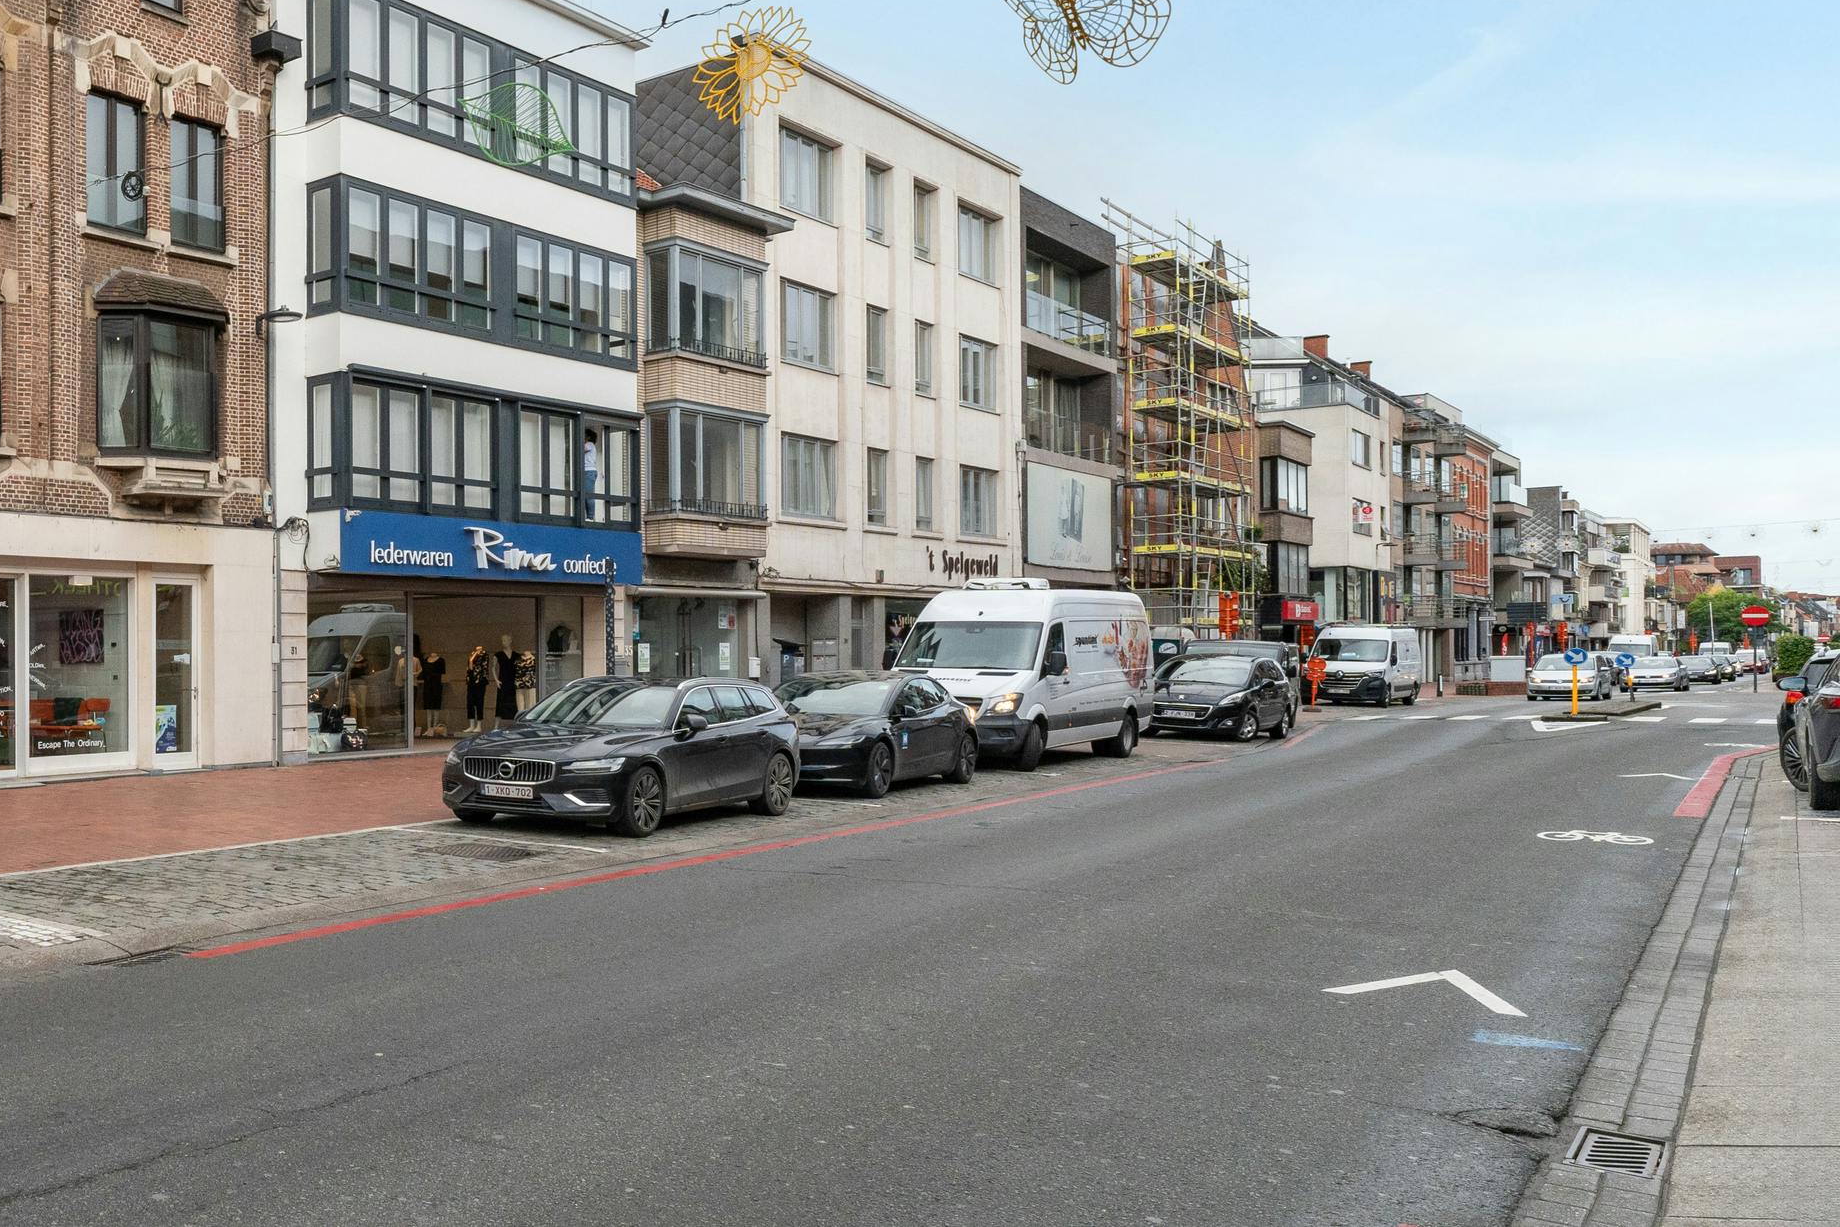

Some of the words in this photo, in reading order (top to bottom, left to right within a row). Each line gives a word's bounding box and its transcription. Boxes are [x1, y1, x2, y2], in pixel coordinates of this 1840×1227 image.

[370, 540, 453, 567] lederwaren
[464, 526, 557, 570] Rima
[563, 554, 617, 575] confect
[942, 550, 998, 581] Spelgeweld
[290, 646, 298, 655] 31
[624, 645, 634, 656] 35
[38, 740, 61, 750] Escape
[63, 739, 75, 748] The
